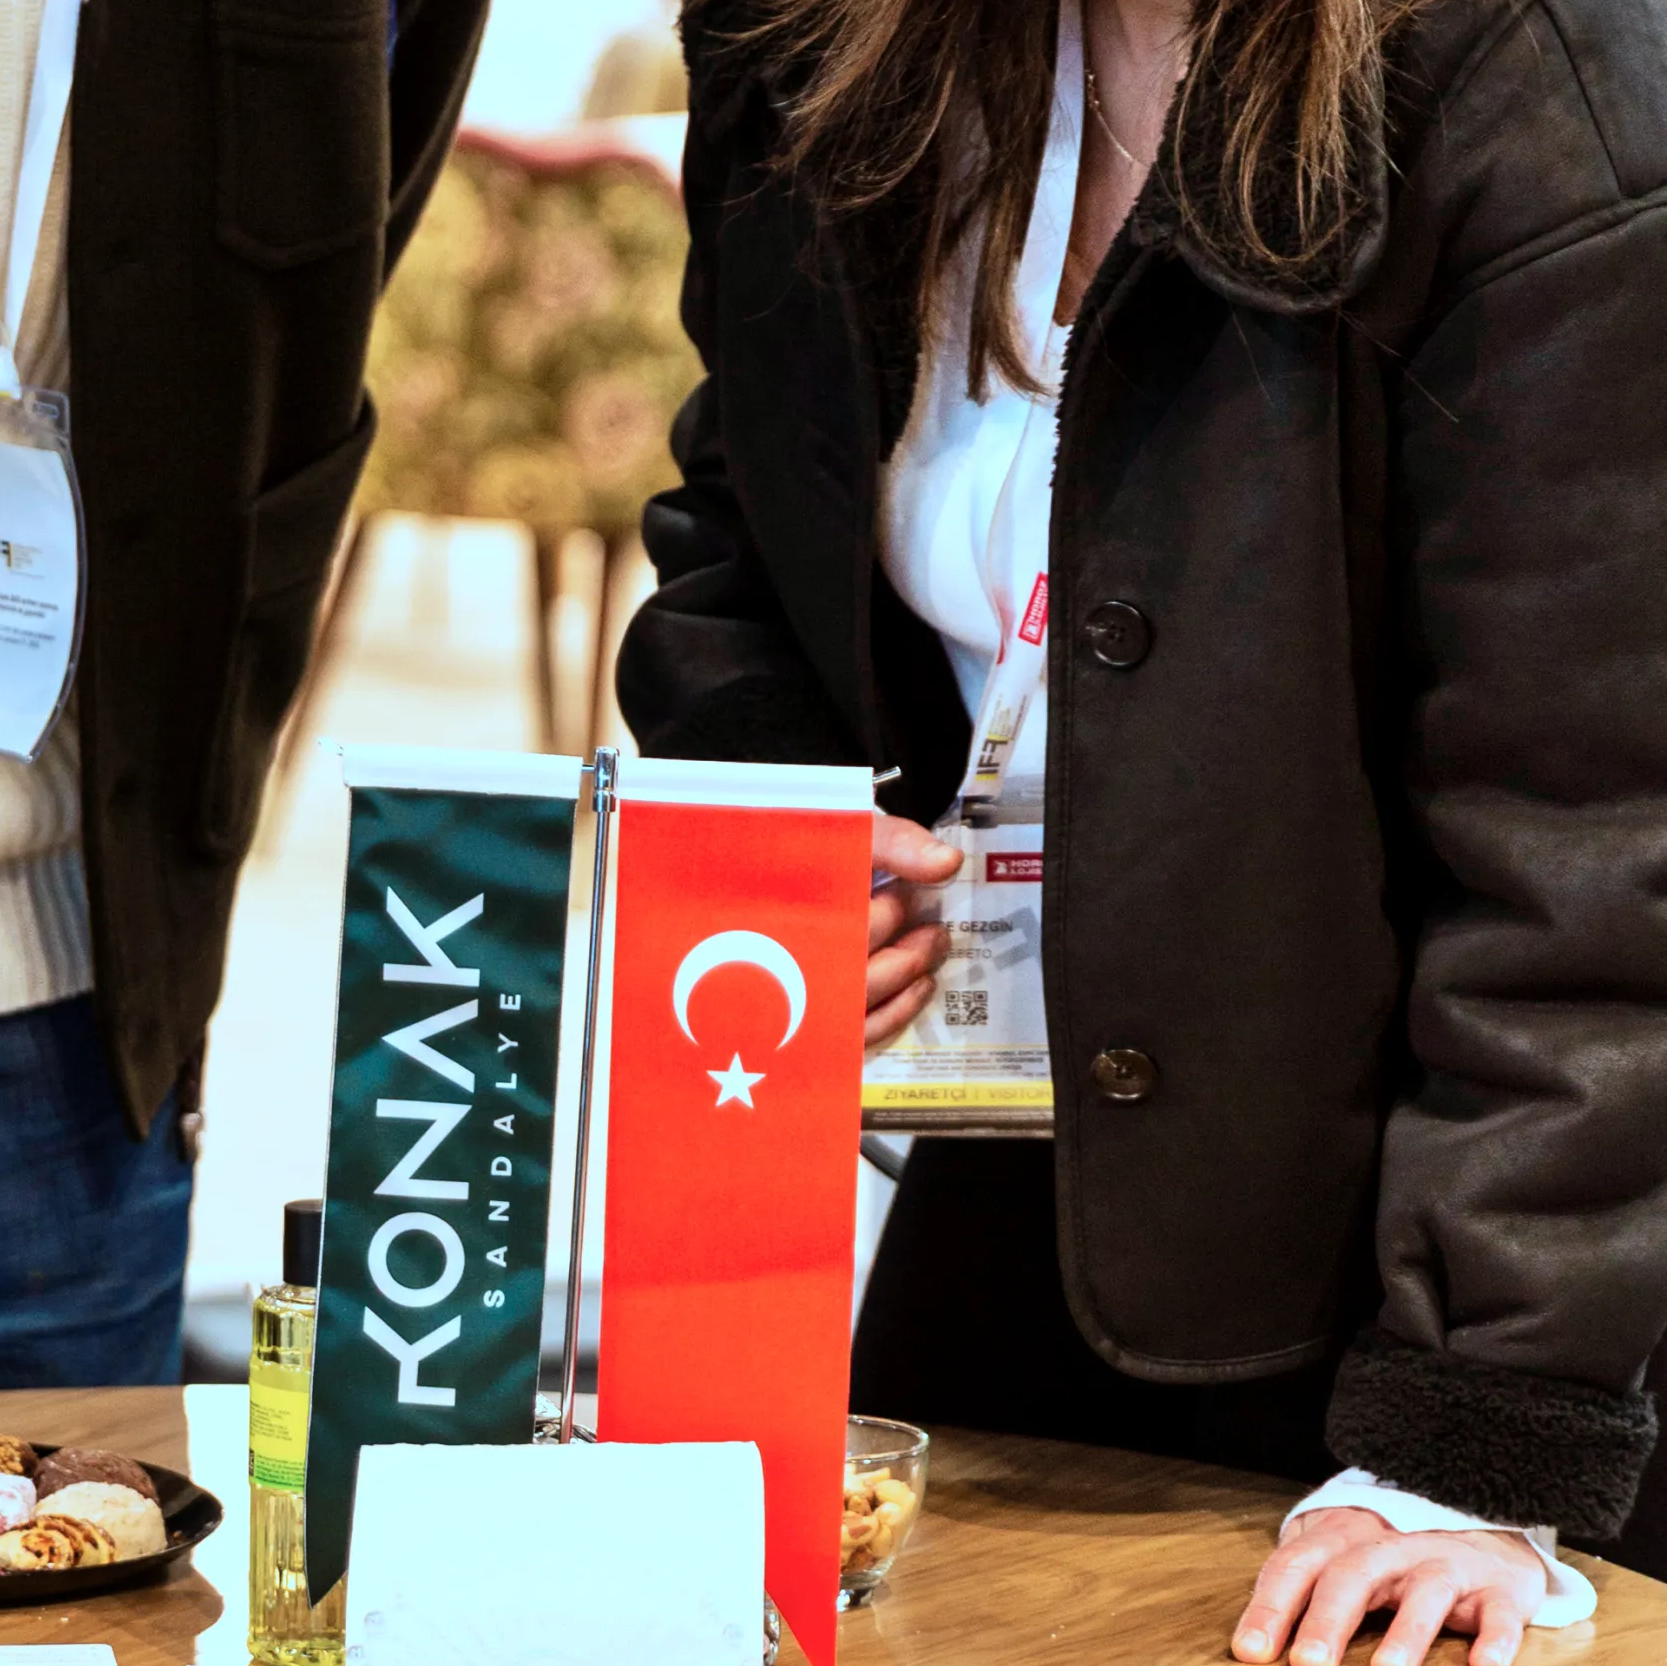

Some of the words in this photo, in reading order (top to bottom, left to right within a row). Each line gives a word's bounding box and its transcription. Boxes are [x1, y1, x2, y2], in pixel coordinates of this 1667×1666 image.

[959, 918, 1014, 933] GEZGİN
[362, 886, 485, 1408] KONAK
[483, 992, 522, 1309] SANDALYE
